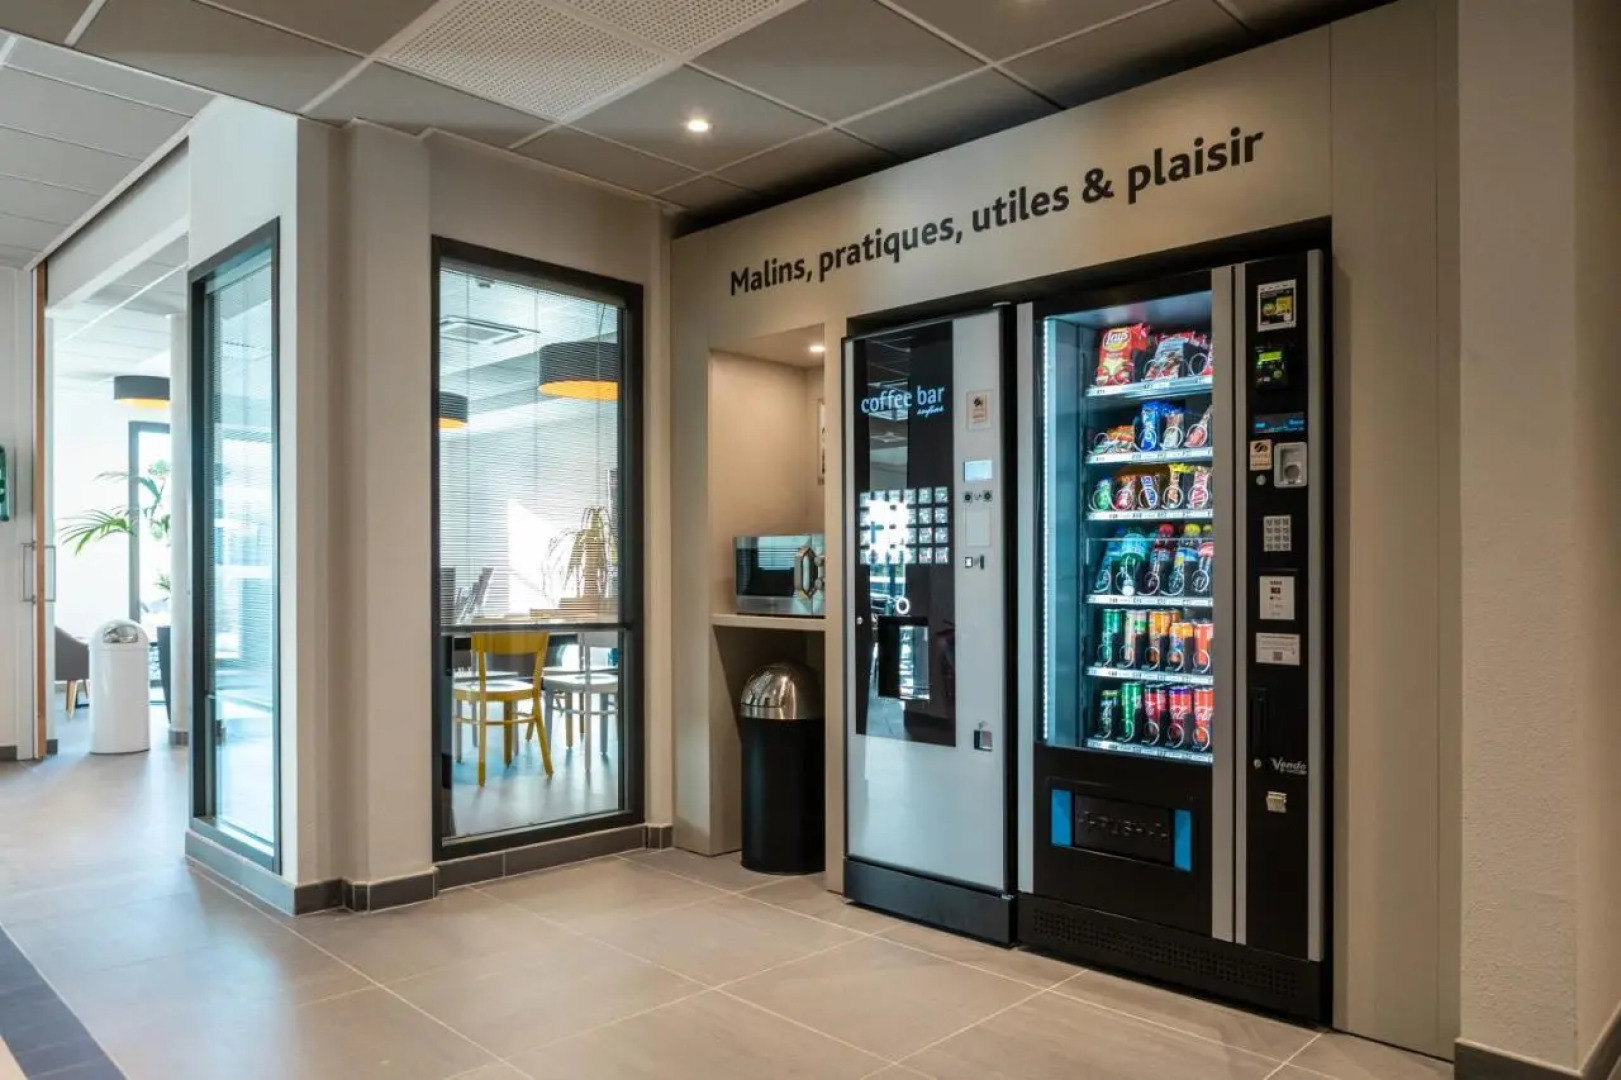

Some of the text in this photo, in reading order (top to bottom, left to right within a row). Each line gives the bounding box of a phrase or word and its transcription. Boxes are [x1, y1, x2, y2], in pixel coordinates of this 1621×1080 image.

[730, 126, 1264, 296] Malins, pratiques, utiles & plaisir
[861, 384, 946, 413] coffee bar
[1269, 756, 1308, 775] Vendo
